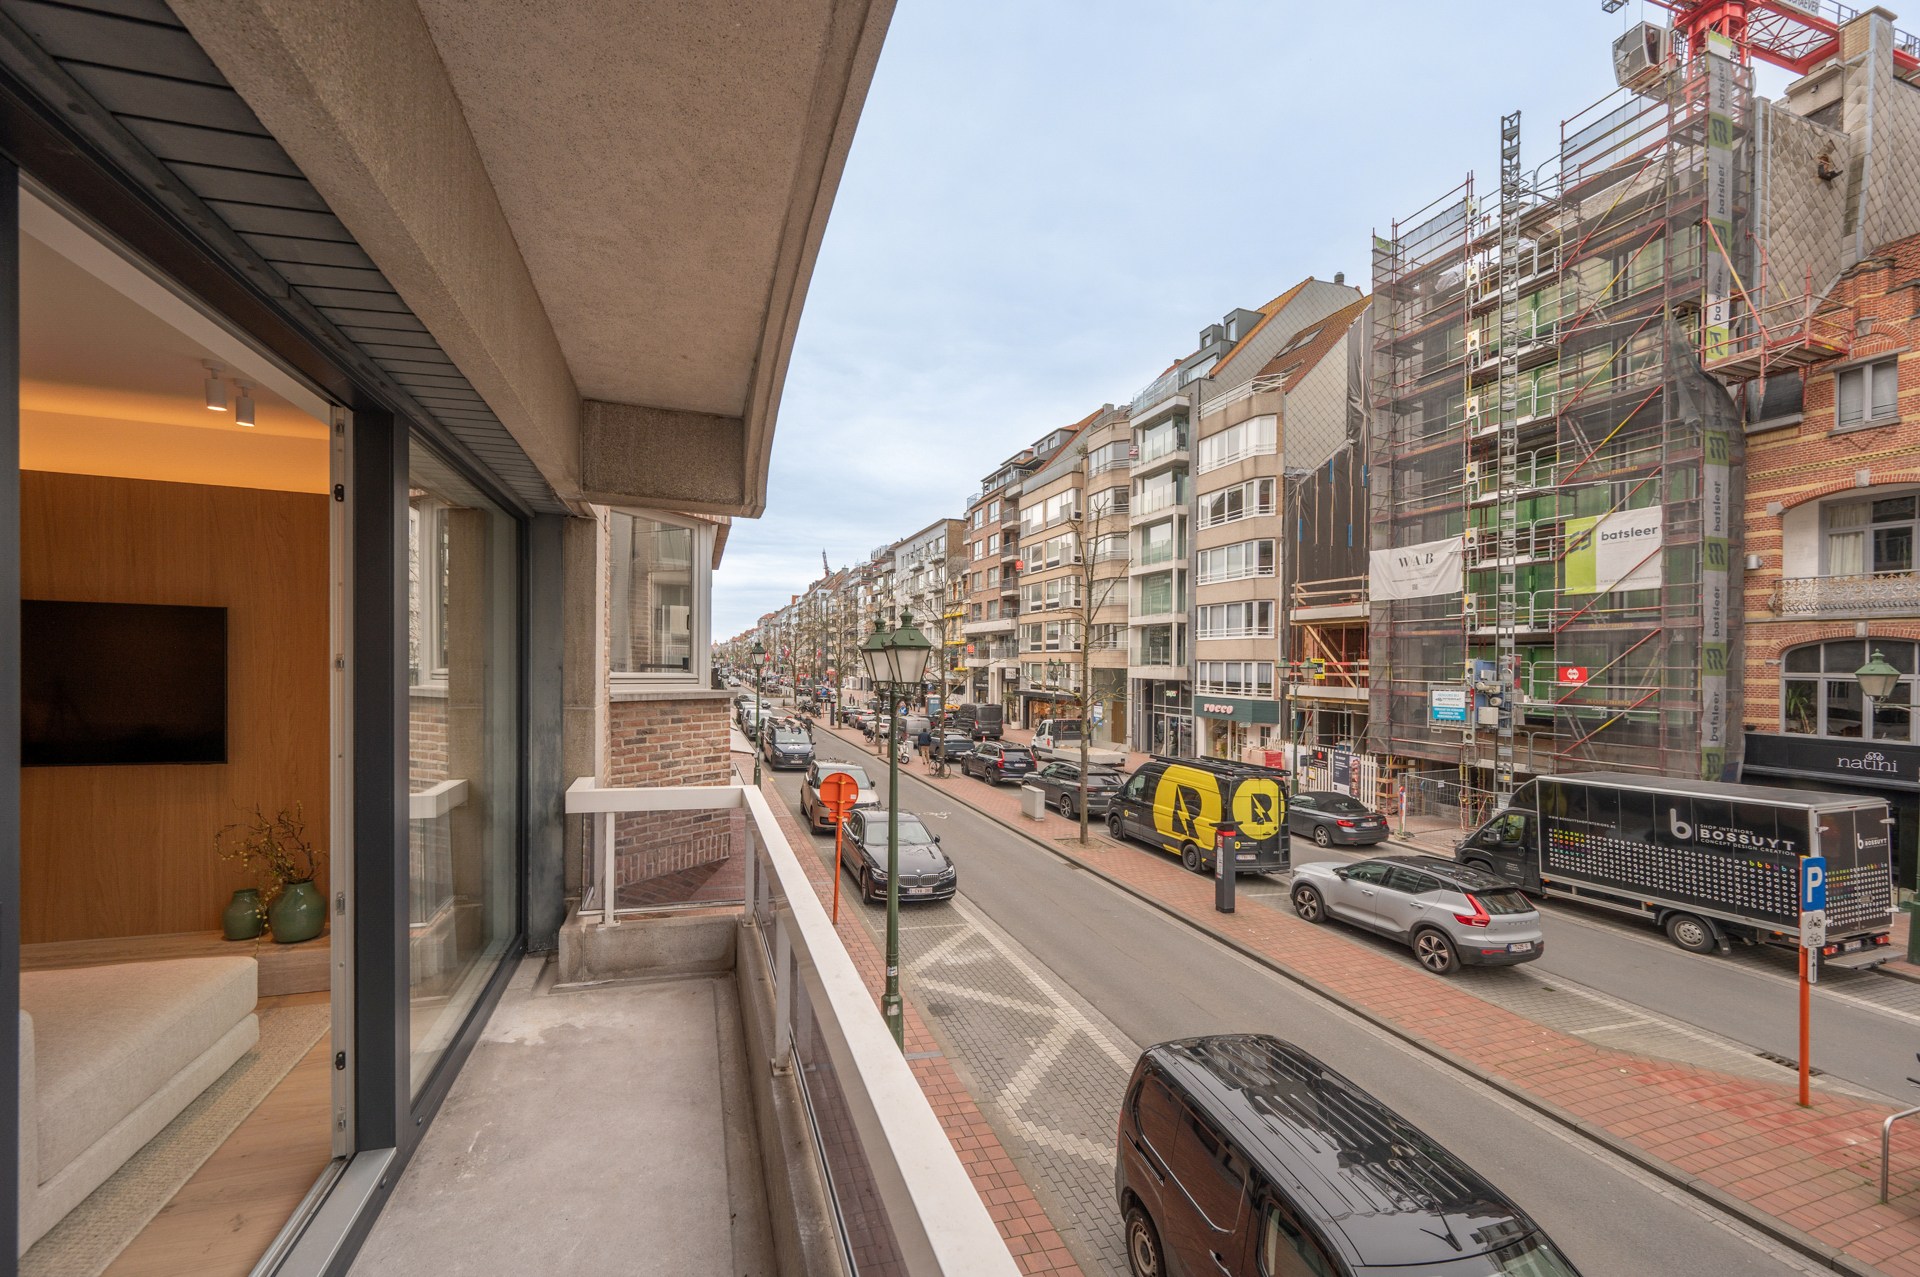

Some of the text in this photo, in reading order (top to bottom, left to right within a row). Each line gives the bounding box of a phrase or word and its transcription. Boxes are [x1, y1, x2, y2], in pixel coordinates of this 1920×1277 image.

[1717, 61, 1727, 110] batsleer
[1717, 165, 1727, 215] batsleer
[1713, 480, 1722, 532] batsleer
[1601, 526, 1658, 541] batsleer
[1712, 586, 1721, 637] batsleer
[1203, 703, 1234, 715] rocco
[1709, 691, 1720, 742] batsleer
[1837, 756, 1899, 773] natini
[1700, 828, 1795, 851] BOSSUYT
[1719, 826, 1755, 836] INTERIORS
[1865, 838, 1887, 847] BOSSUYT
[1700, 838, 1796, 857] CONCEPT DESIGN CREATION
[1807, 866, 1823, 903] P
